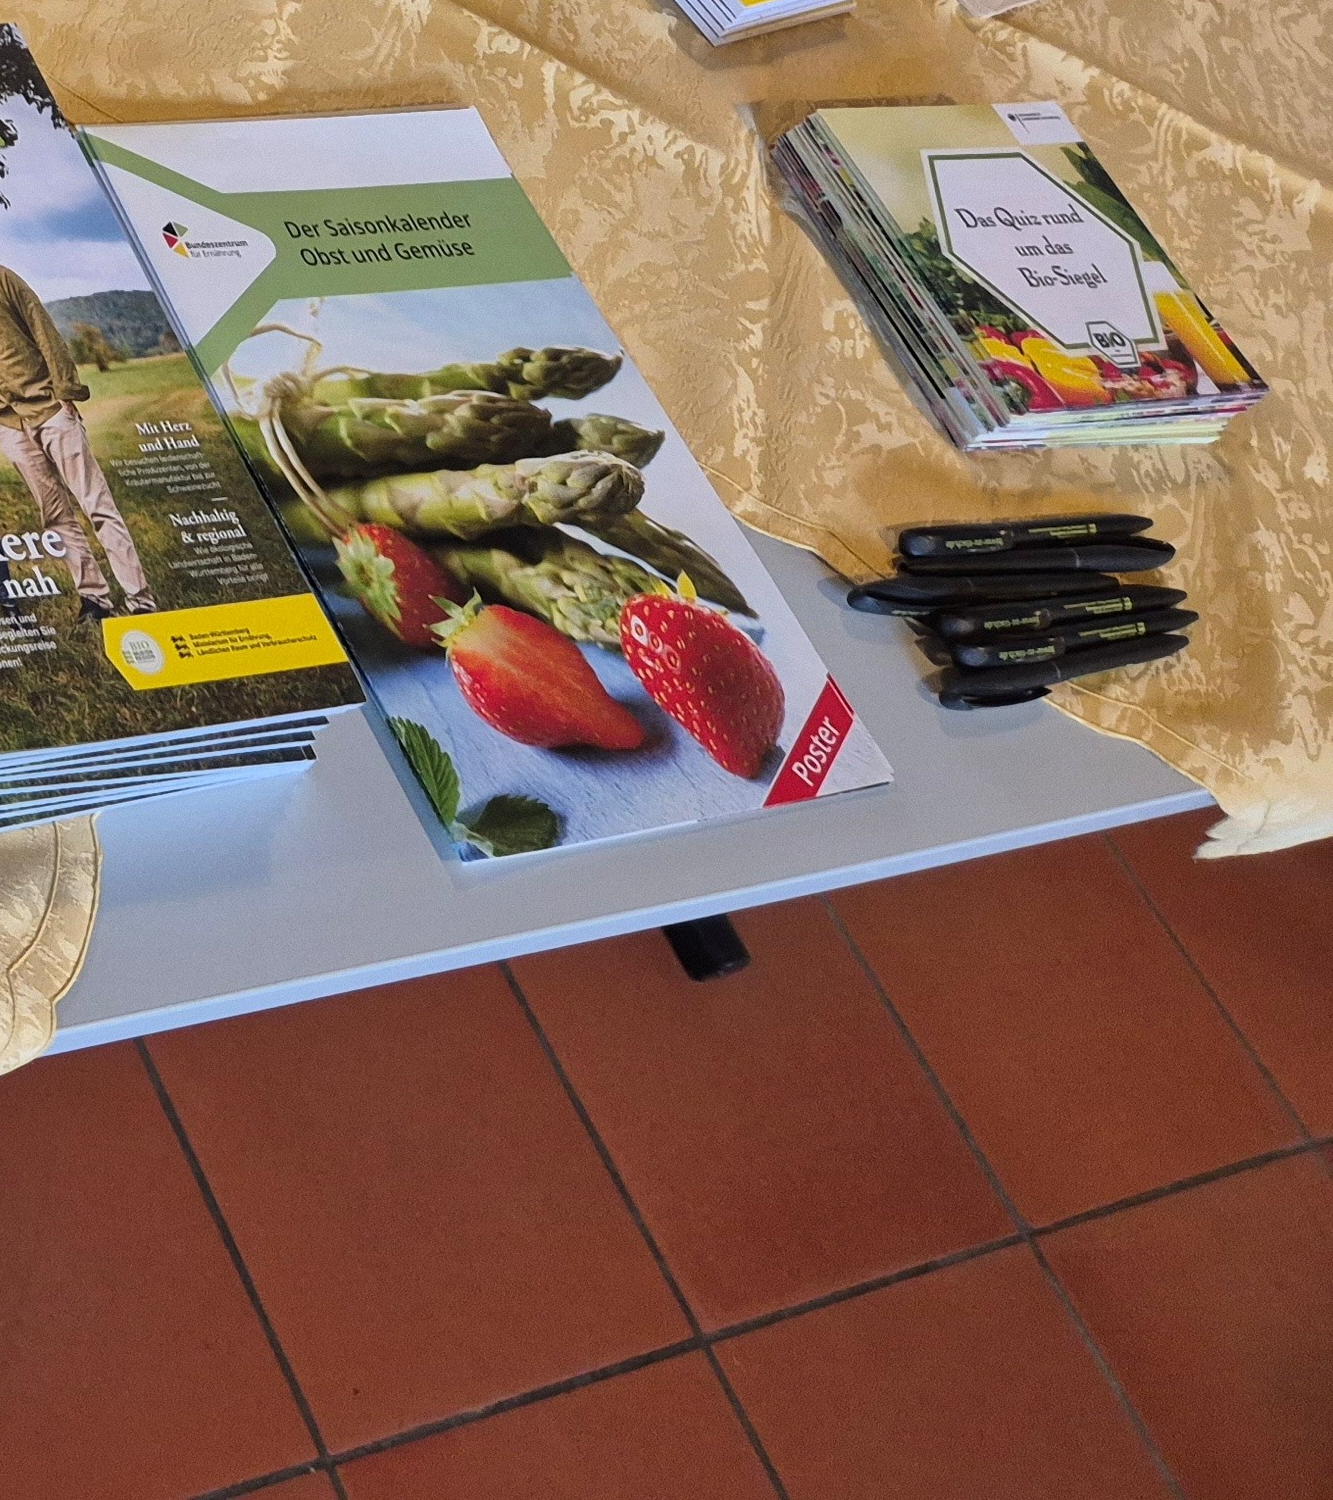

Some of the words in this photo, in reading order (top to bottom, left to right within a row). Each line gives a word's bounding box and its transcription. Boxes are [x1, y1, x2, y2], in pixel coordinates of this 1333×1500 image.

[283, 220, 321, 239] Der
[324, 210, 472, 238] Saisonkalender
[954, 208, 997, 229] Das
[993, 206, 1042, 231] Quiz
[1042, 203, 1084, 226] rund
[300, 246, 351, 267] Obst
[354, 242, 393, 263] und
[394, 239, 476, 261] Gemüse
[1014, 245, 1043, 257] um
[1042, 235, 1074, 255] das
[1017, 263, 1108, 289] Bio-Siegel
[1093, 331, 1126, 349] BIO
[135, 421, 159, 436] Mit
[160, 420, 192, 434] Herz
[138, 439, 163, 453] und
[164, 435, 201, 451] Hand
[168, 508, 240, 528] Nachhaltig
[180, 529, 195, 544] &
[196, 523, 247, 545] regional
[3, 574, 62, 601] nah
[791, 715, 841, 786] Poster
